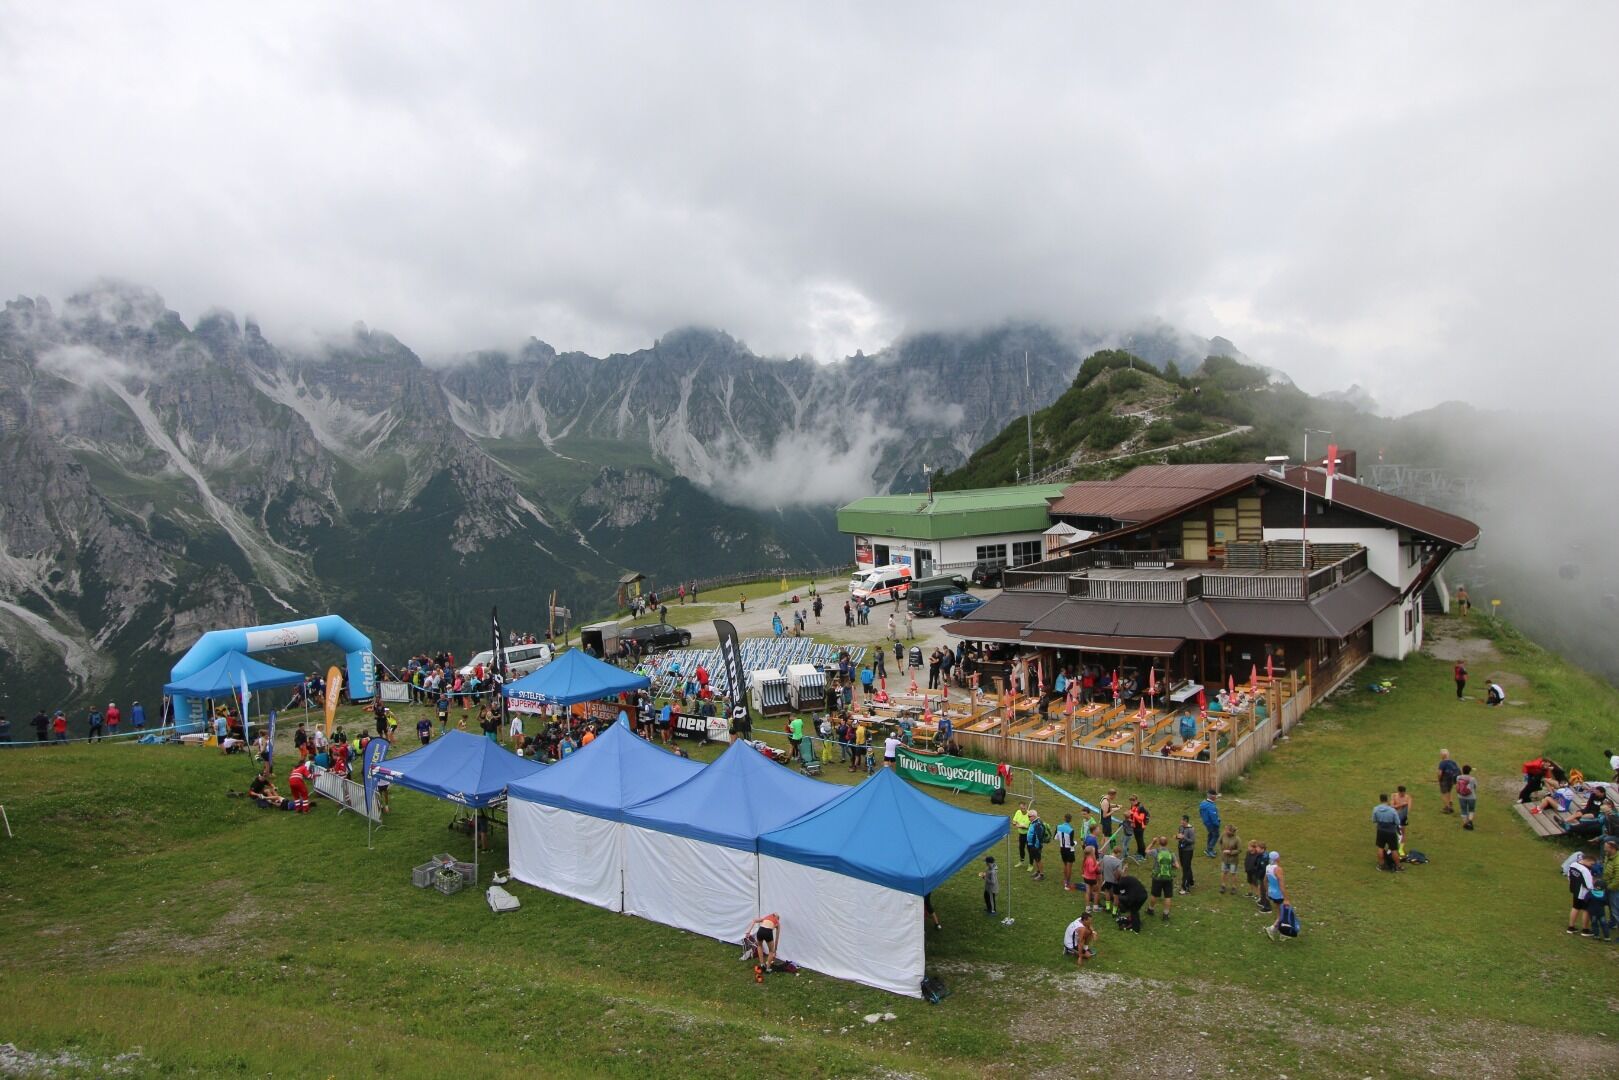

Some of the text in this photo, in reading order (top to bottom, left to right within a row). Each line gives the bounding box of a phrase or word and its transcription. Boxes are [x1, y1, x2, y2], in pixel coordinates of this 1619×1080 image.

[359, 651, 374, 694] stubai
[518, 690, 546, 701] SV-TELFES
[897, 754, 1001, 789] Tiroler Tageszeitung
